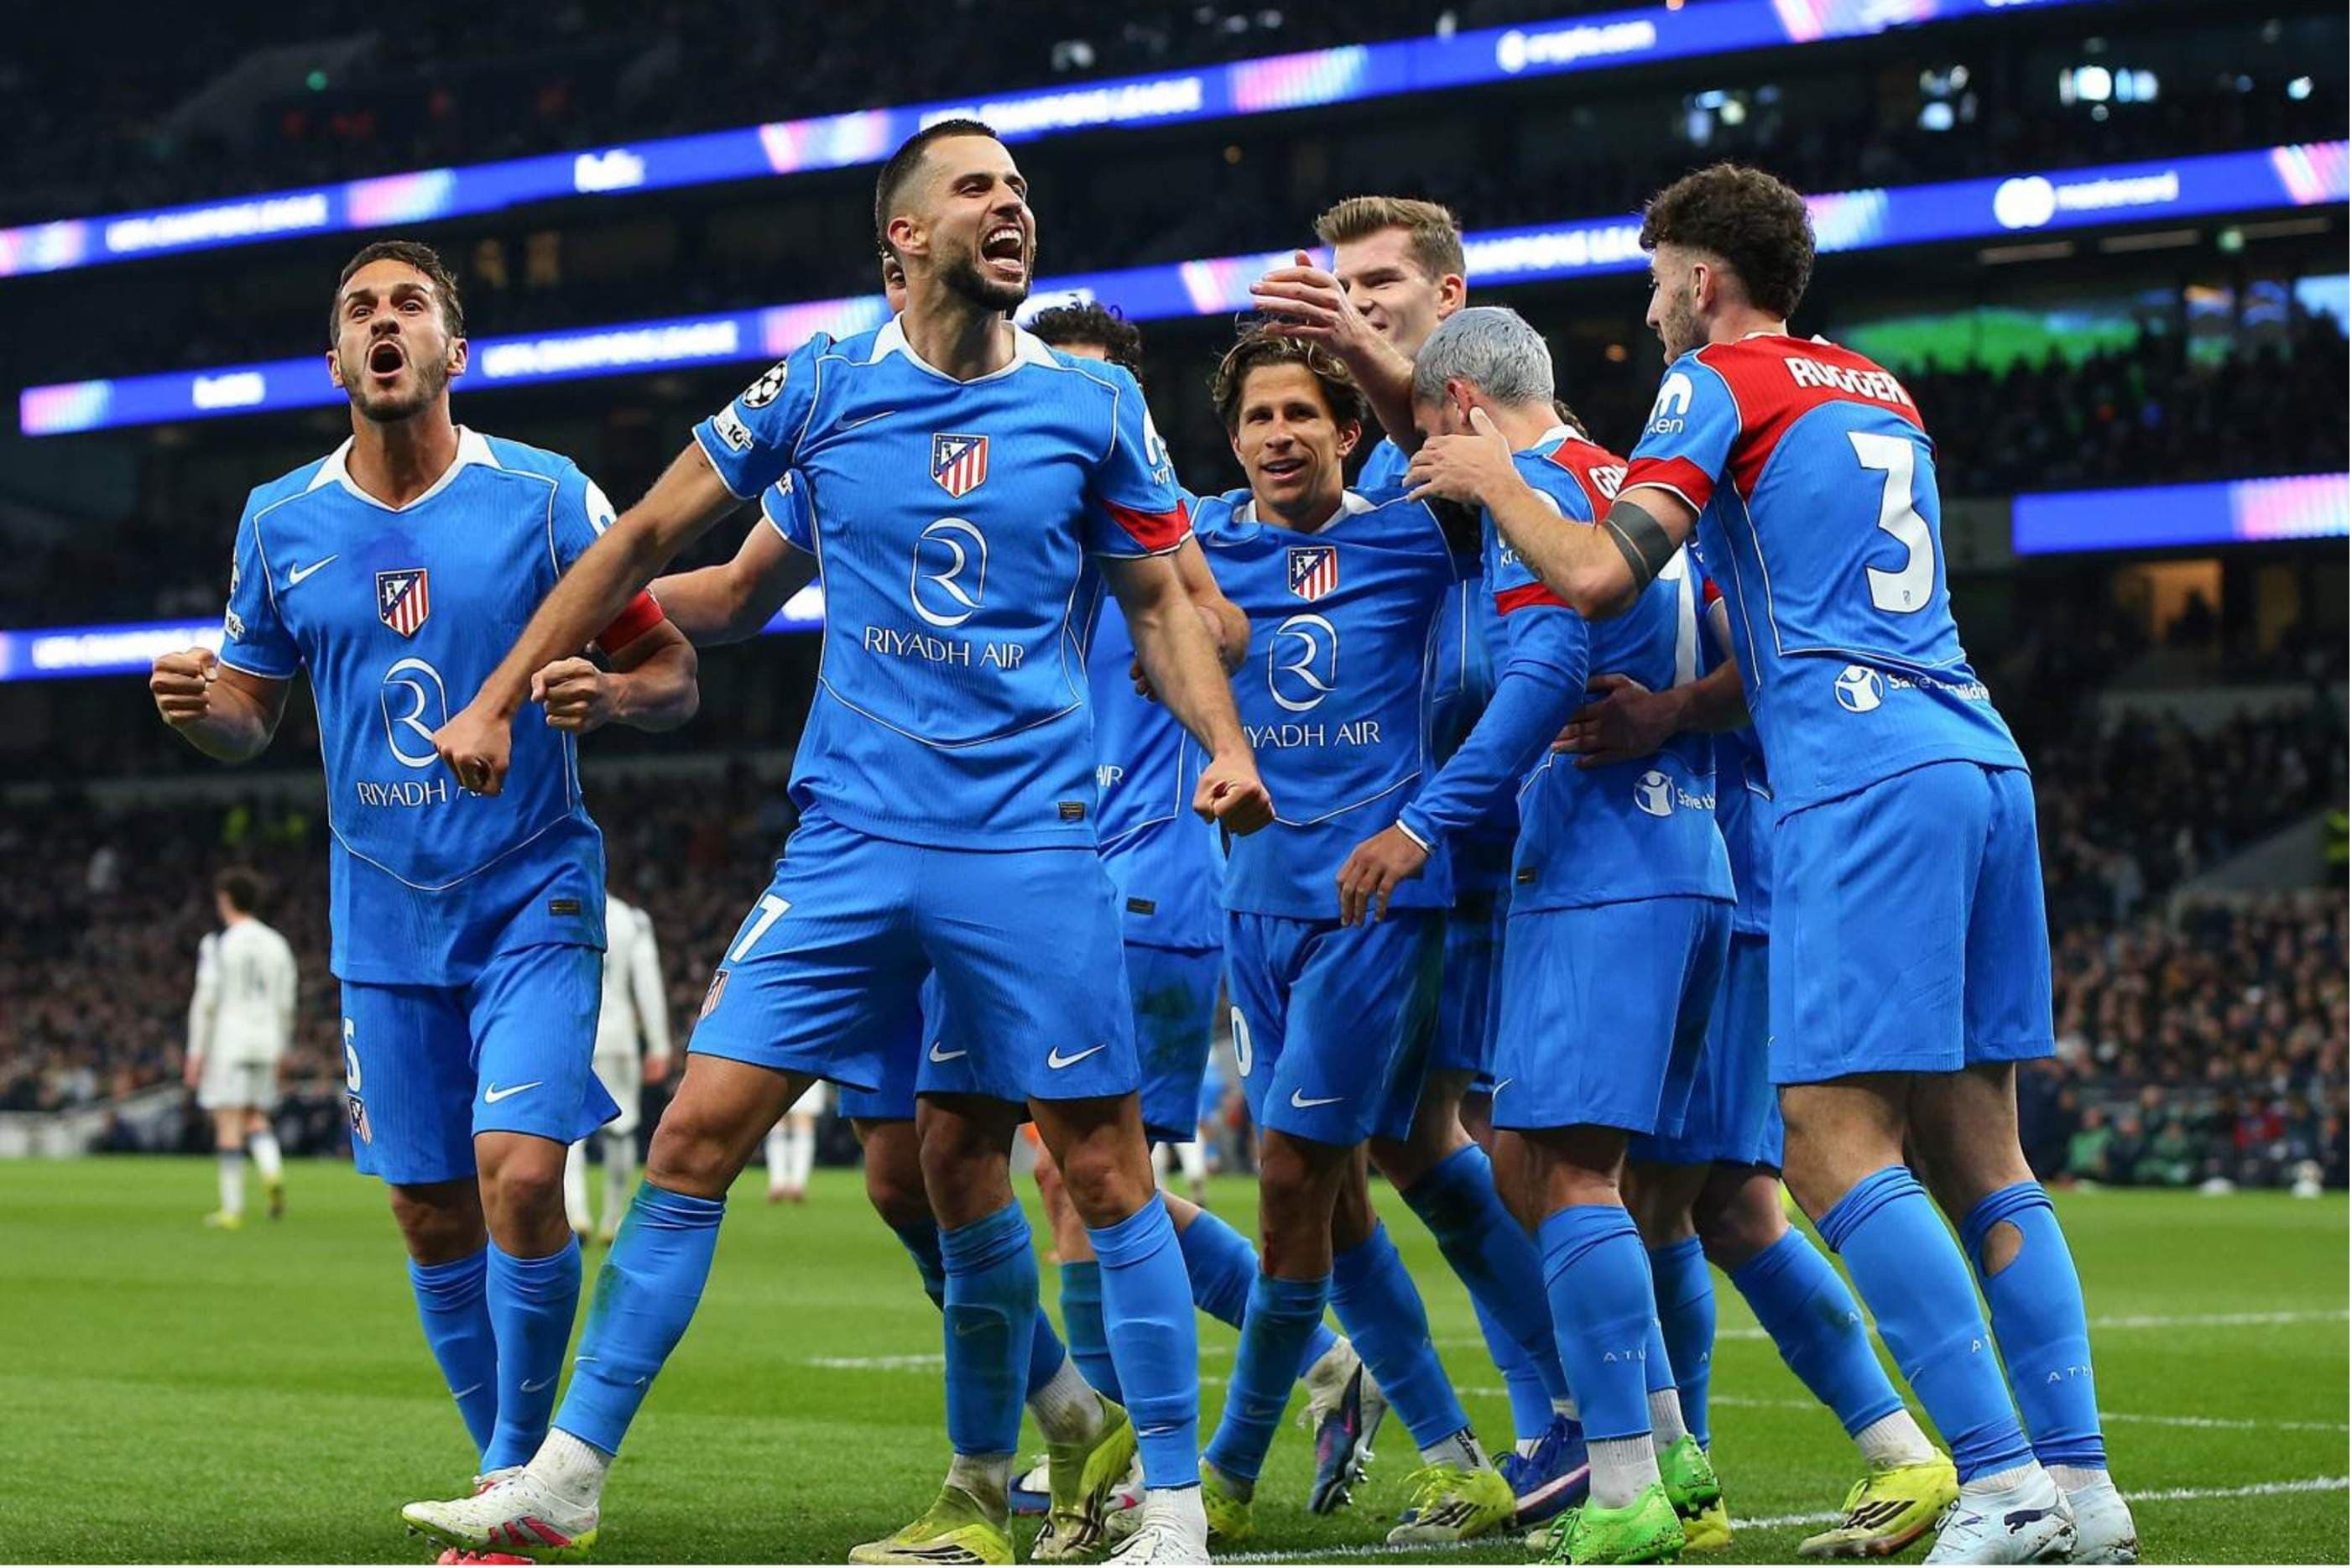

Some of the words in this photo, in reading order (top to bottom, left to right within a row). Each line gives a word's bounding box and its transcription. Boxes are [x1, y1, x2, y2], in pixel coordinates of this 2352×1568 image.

[1846, 430, 1935, 614] 3
[864, 626, 970, 666] RIYADH
[980, 642, 1024, 668] AIR
[1334, 721, 1381, 746] AIR
[357, 779, 447, 807] RIYADH
[1096, 764, 1124, 787] AIR
[729, 893, 793, 963] 7
